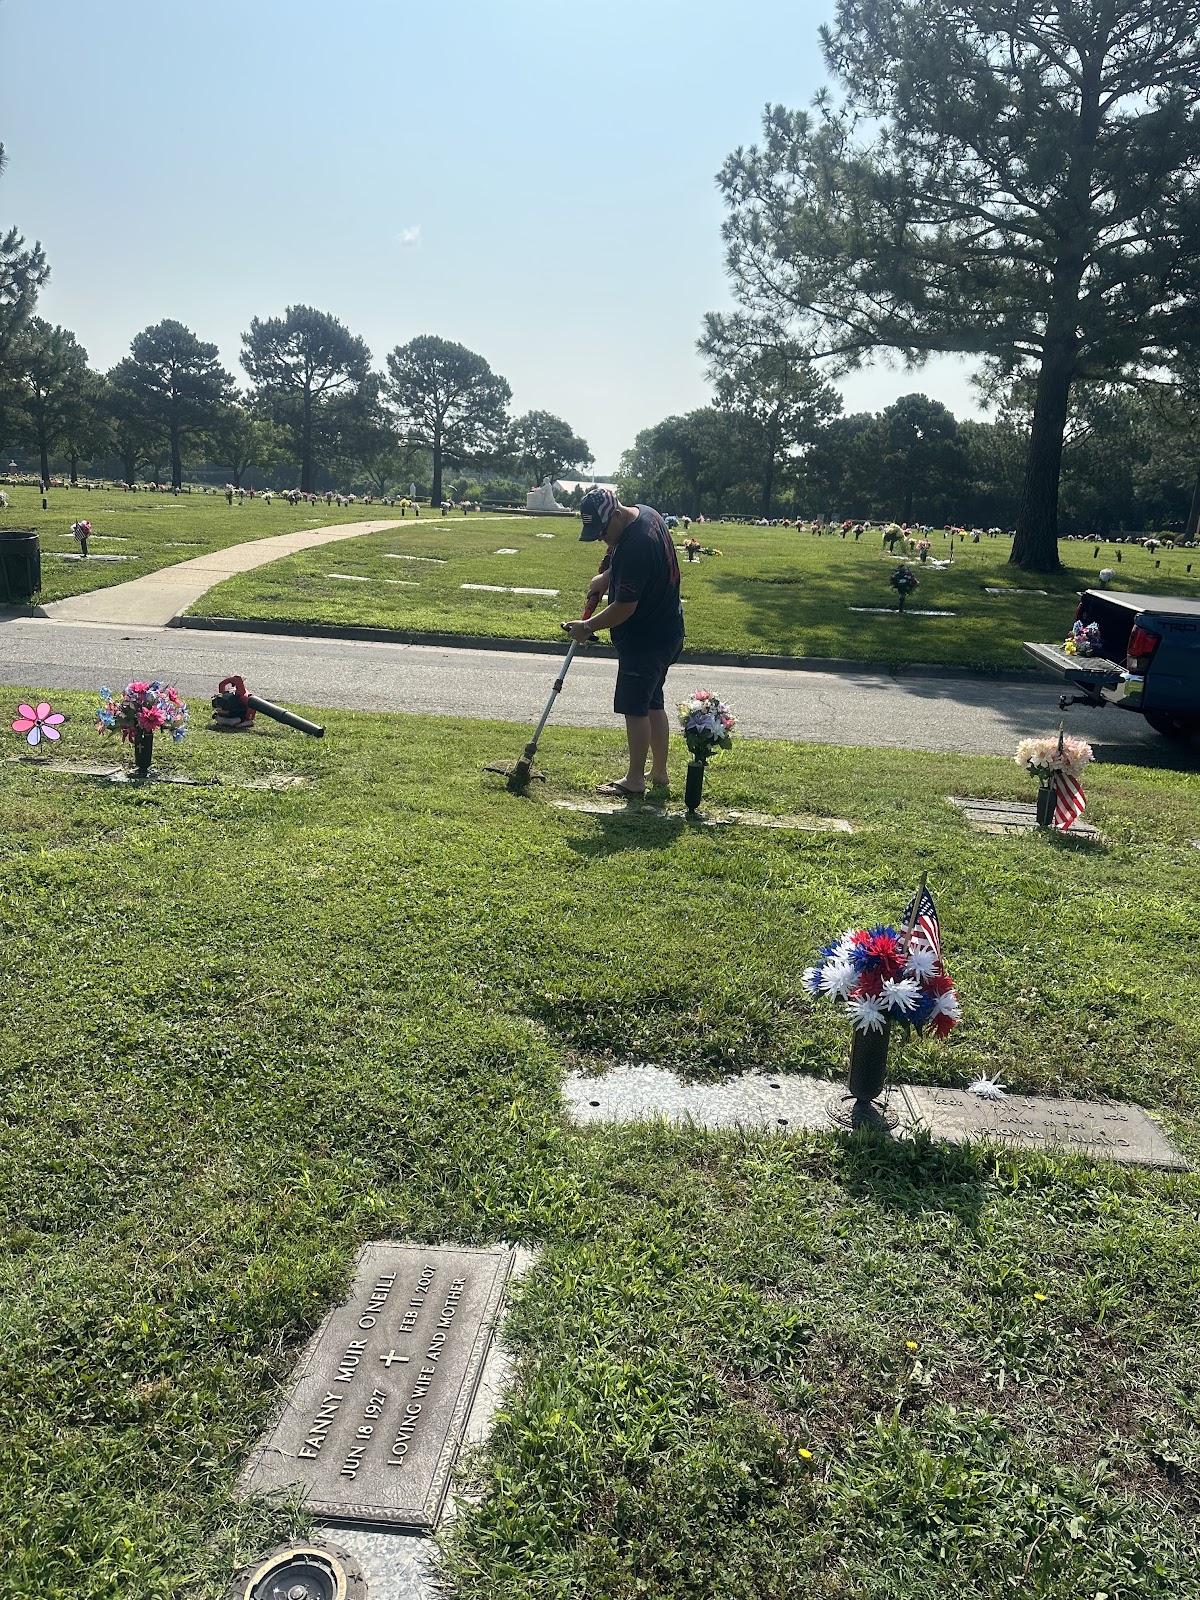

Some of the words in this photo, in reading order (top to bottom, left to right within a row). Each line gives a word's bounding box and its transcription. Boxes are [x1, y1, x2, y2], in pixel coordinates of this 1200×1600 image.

[1067, 1133, 1130, 1147] CALVIN
[415, 1263, 438, 1294] 2007
[410, 1297, 425, 1309] 11
[399, 1310, 417, 1334] FEB
[298, 1391, 343, 1460] FANNY
[334, 1339, 368, 1383] MUIR
[359, 1271, 398, 1330] O'NEILL
[388, 1403, 422, 1466] LOVING
[412, 1365, 436, 1398] WIFE
[427, 1332, 447, 1362] AND
[437, 1276, 467, 1330] MOTHER
[364, 1388, 388, 1421] 1927
[356, 1424, 374, 1441] 18
[341, 1446, 366, 1480] JUN
